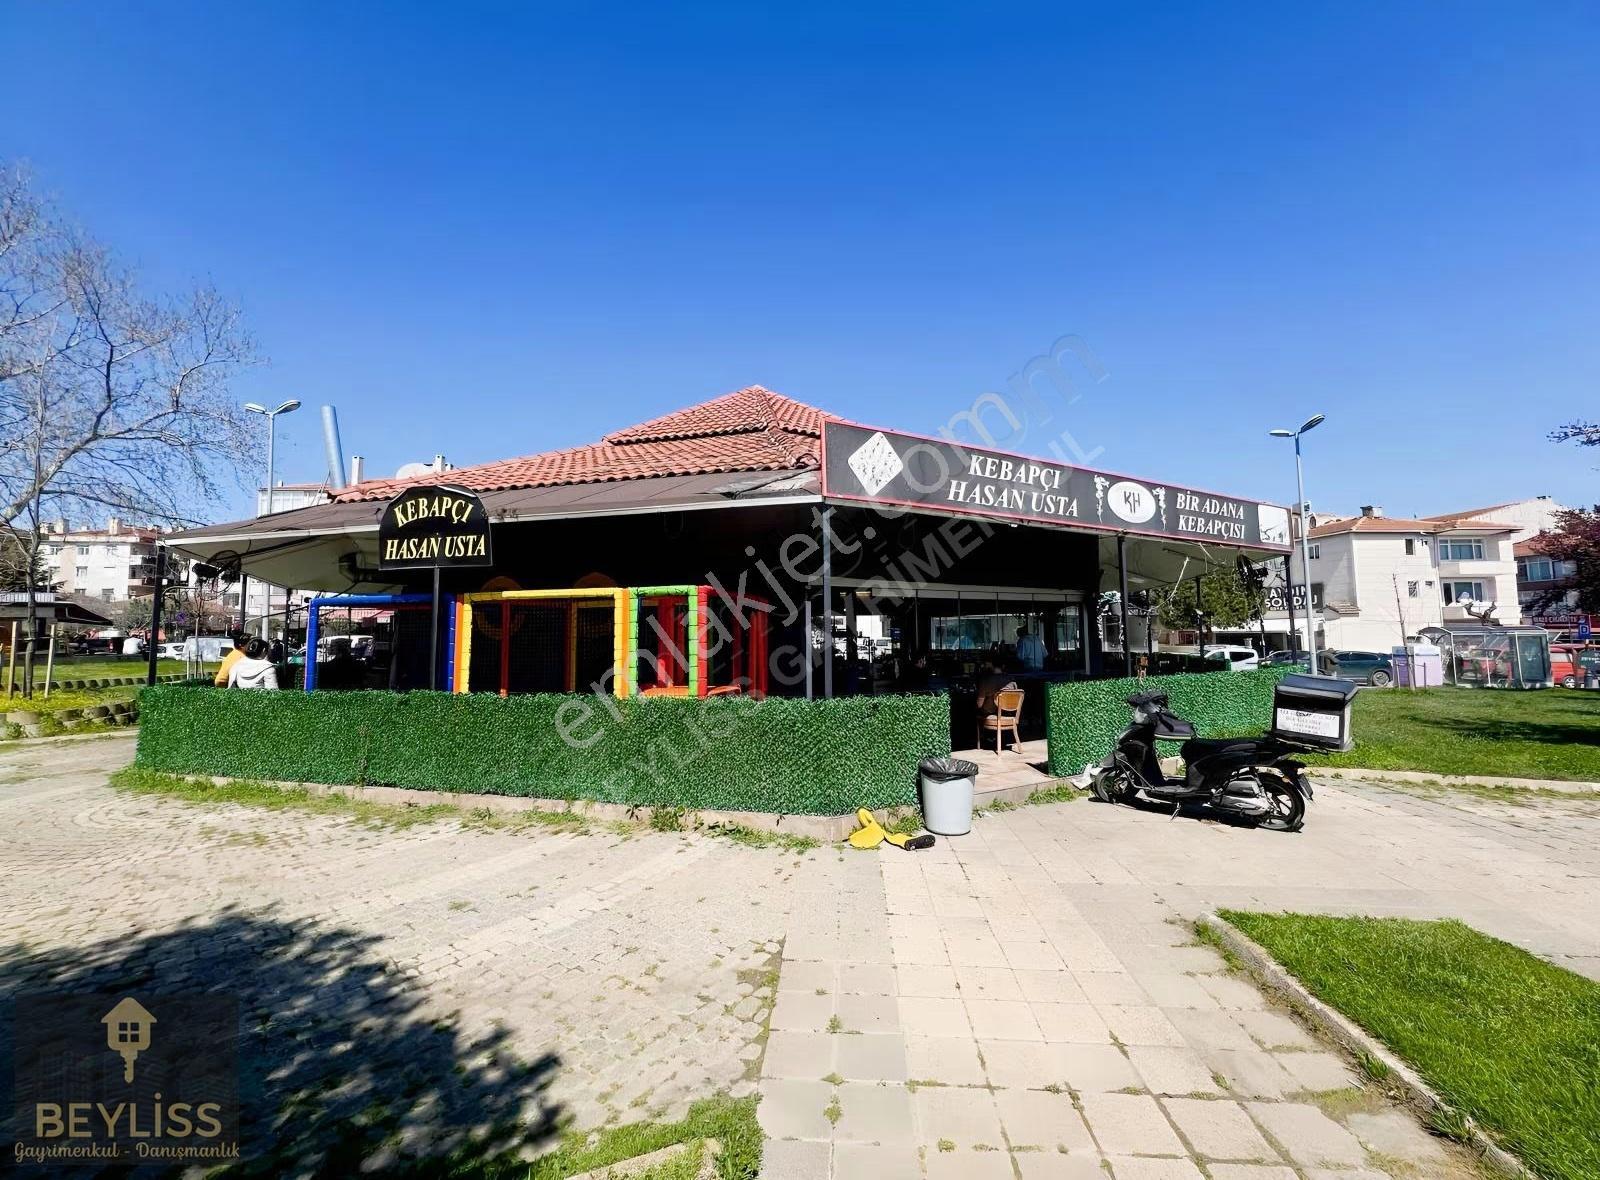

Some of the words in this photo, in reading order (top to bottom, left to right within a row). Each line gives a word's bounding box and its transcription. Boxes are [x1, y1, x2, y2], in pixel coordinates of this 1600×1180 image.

[968, 454, 1061, 491] KEBAPÇI
[394, 496, 474, 528] KEBAPÇI
[947, 480, 1026, 510] HASAN
[1031, 493, 1079, 517] USTA
[1176, 491, 1200, 512] BİR
[1201, 498, 1244, 520] ADANA
[1178, 515, 1245, 539] KEBAPÇISI
[385, 536, 441, 560] HASAN
[444, 534, 486, 557] USTA
